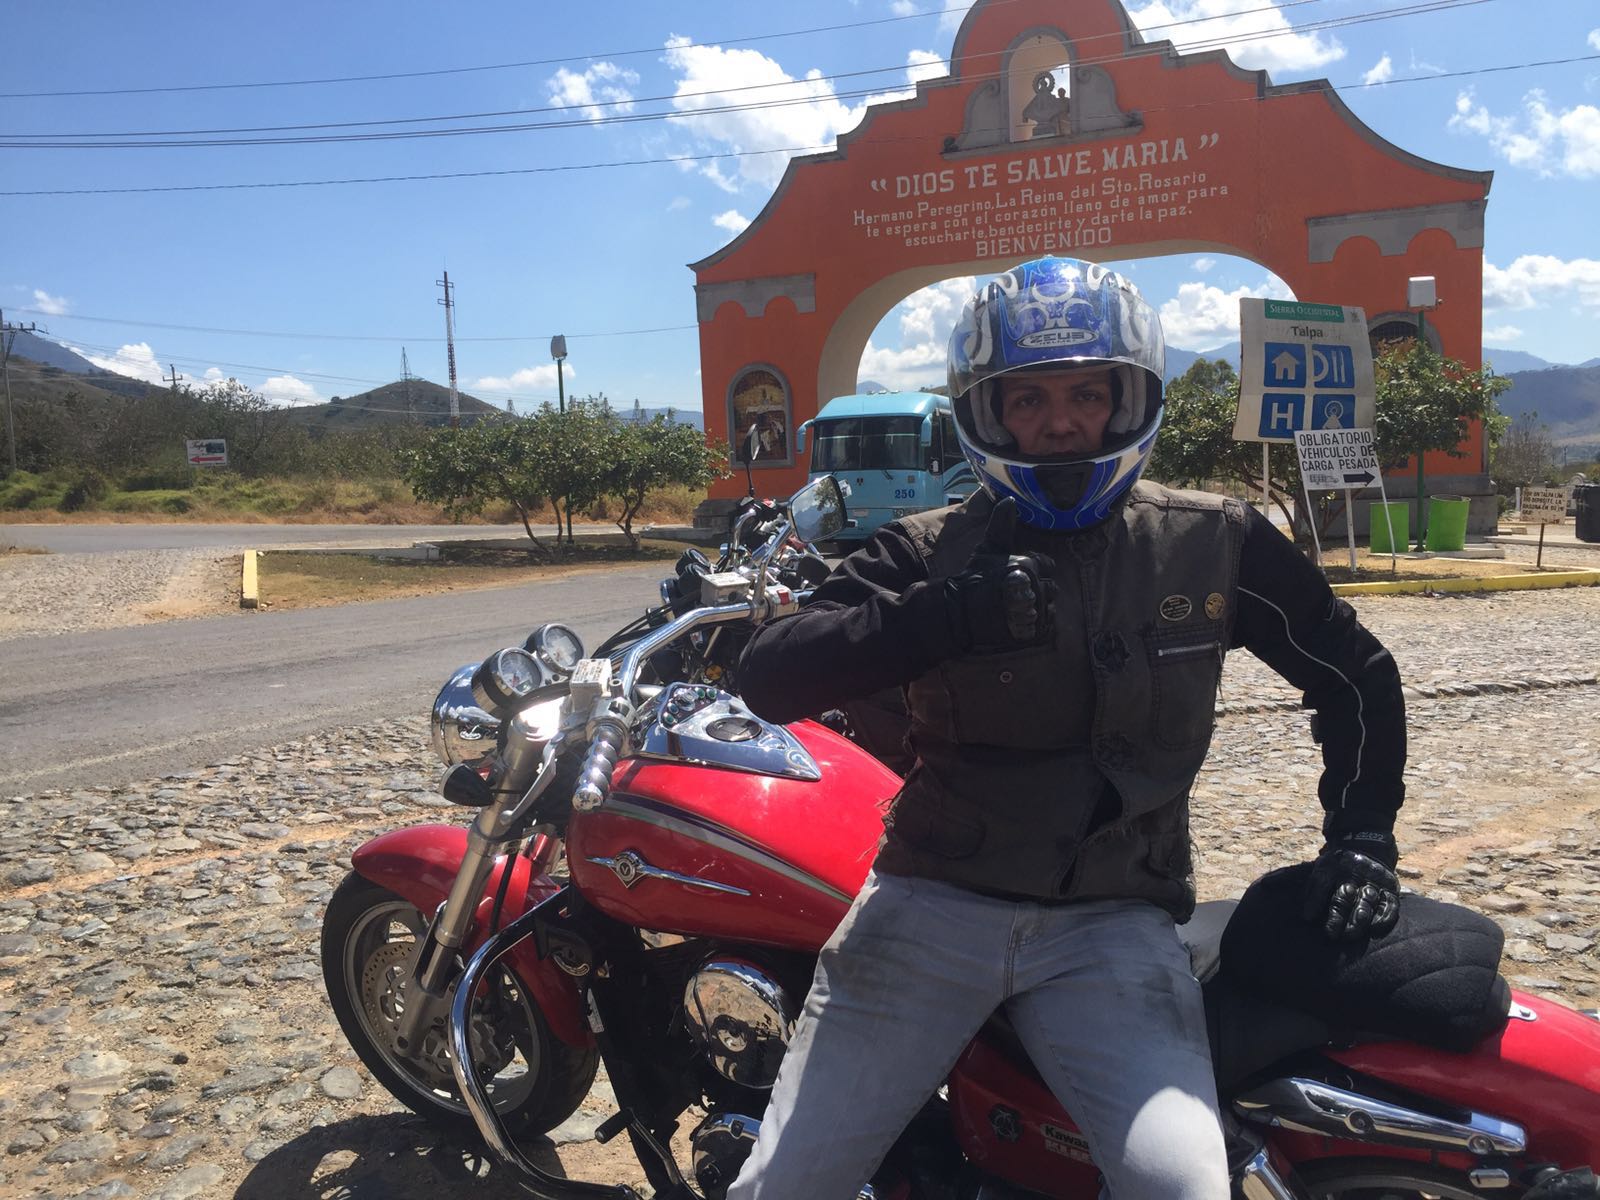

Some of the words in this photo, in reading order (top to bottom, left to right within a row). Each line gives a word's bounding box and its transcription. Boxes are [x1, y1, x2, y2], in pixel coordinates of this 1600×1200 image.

[896, 169, 955, 199] DIOS
[964, 163, 998, 189] TE
[1102, 137, 1188, 172] MARIA
[853, 209, 913, 226] Hermano
[1020, 188, 1064, 206] Reina
[1071, 184, 1095, 199] del
[867, 226, 880, 238] te
[886, 222, 937, 237] espera
[944, 217, 968, 229] con
[975, 212, 988, 225] el
[1064, 201, 1102, 215] lleno
[1110, 194, 1129, 209] de
[1138, 191, 1178, 205] amor
[1187, 185, 1228, 204] para
[1077, 218, 1085, 231] y
[1091, 210, 1134, 226] darte
[1140, 206, 1152, 220] la
[1158, 206, 1193, 222] paz.
[975, 227, 1112, 257] BIENVENIDO
[1291, 326, 1323, 340] Talpa
[1271, 402, 1294, 429] H
[1299, 431, 1371, 446] OBLIGATORIO
[1300, 446, 1356, 459] VEHICULOS
[1361, 445, 1375, 457] DE
[1301, 459, 1335, 472] CARGA
[1339, 457, 1378, 470] PESADA
[895, 488, 915, 499] 250
[1045, 1125, 1090, 1149] Kawas
